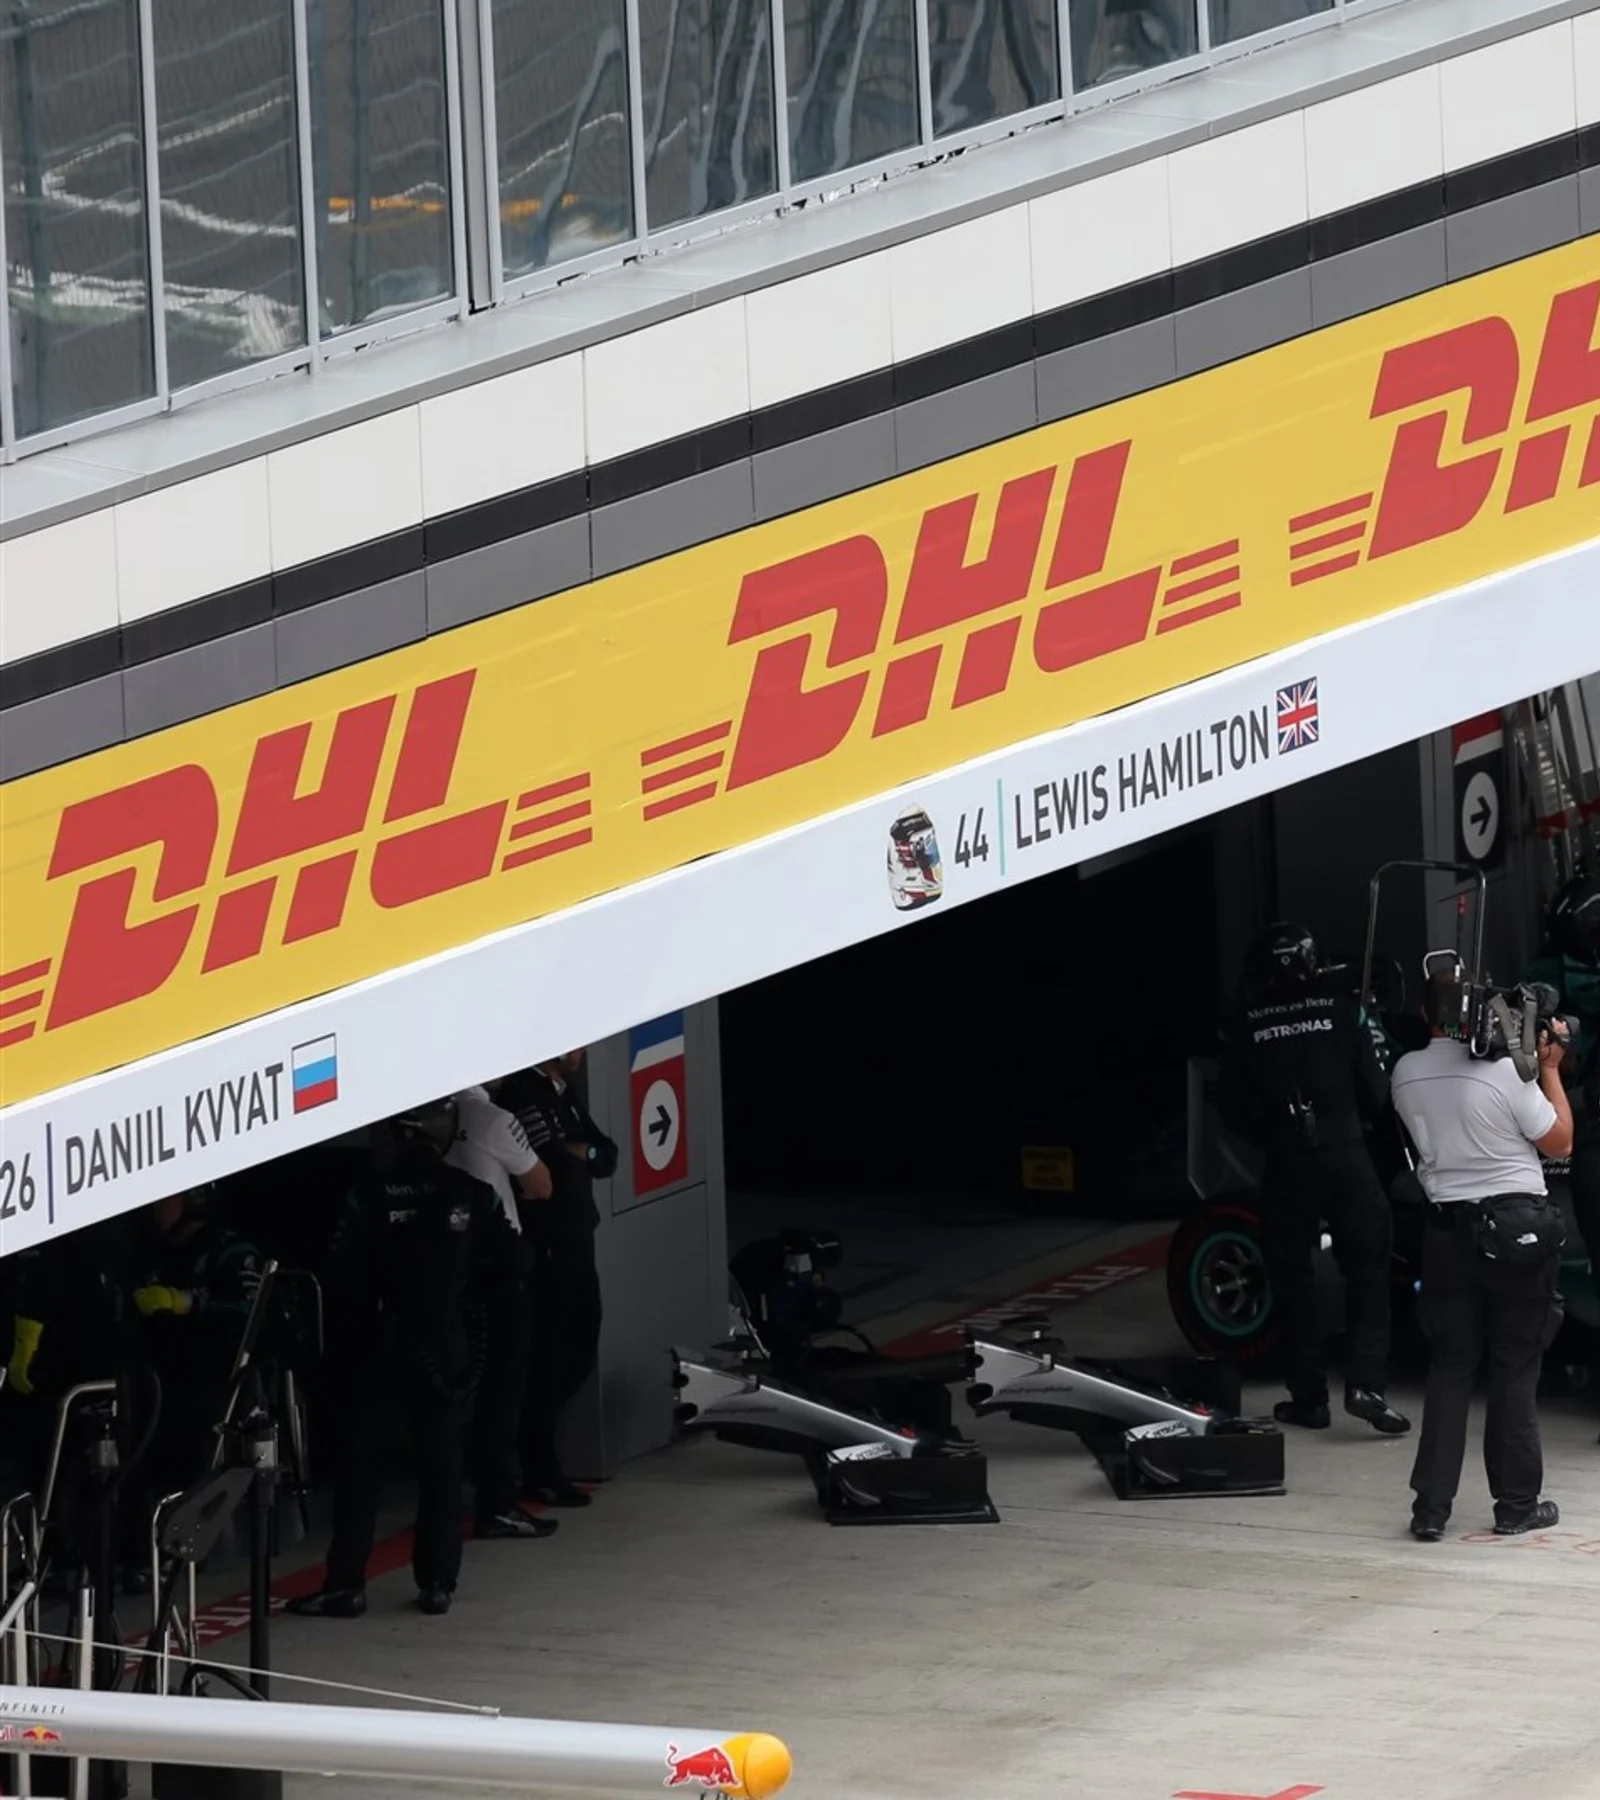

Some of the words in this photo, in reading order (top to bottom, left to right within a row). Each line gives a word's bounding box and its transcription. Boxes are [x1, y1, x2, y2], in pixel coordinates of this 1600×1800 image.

[724, 439, 1164, 793] DHL
[45, 669, 510, 1032] DHL
[954, 806, 990, 868] 44
[1015, 764, 1110, 850] LEWIS
[1117, 704, 1270, 813] HAMILTON
[1252, 1018, 1334, 1044] PETRONAS
[0, 1152, 36, 1220] 26
[65, 1105, 176, 1196] DANIIL
[184, 1062, 284, 1153] KVYAT
